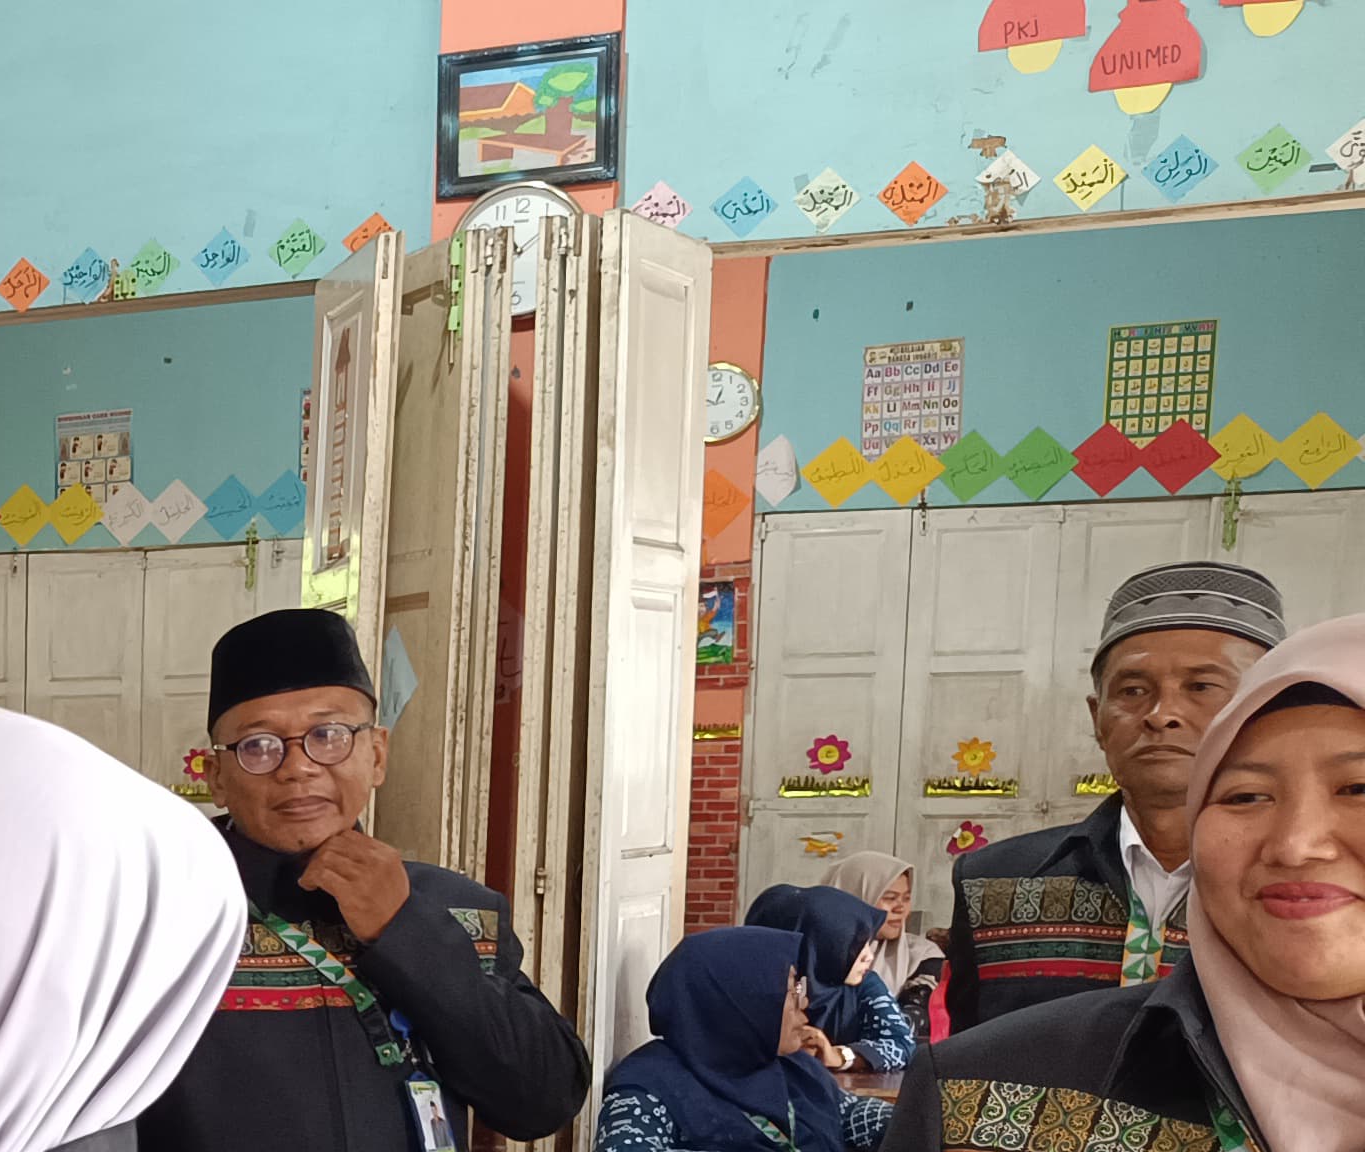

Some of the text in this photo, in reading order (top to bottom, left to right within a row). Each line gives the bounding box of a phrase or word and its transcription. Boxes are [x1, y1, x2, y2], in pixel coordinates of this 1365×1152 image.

[1100, 43, 1181, 75] UNIMED
[515, 197, 530, 214] 12
[495, 205, 507, 221] 11
[905, 366, 919, 375] Cc
[925, 364, 939, 373] Dd
[945, 362, 958, 372] Ee
[866, 369, 880, 378] Aa
[885, 368, 900, 377] Bb
[736, 384, 746, 394] 2
[904, 384, 919, 393] Hh
[947, 381, 955, 392] Jj
[867, 387, 878, 397] Ff
[740, 396, 749, 407] 3
[902, 402, 919, 410] Mm
[923, 400, 938, 409] Nn
[943, 398, 958, 408] Oo
[724, 420, 734, 430] 5
[904, 419, 917, 429] Rr
[945, 416, 955, 426] Tt
[710, 425, 719, 435] 6
[865, 422, 878, 434] Pp
[884, 421, 899, 432] Qq
[923, 436, 936, 445] Xx
[943, 434, 955, 444] Yy
[864, 441, 878, 450] Uu
